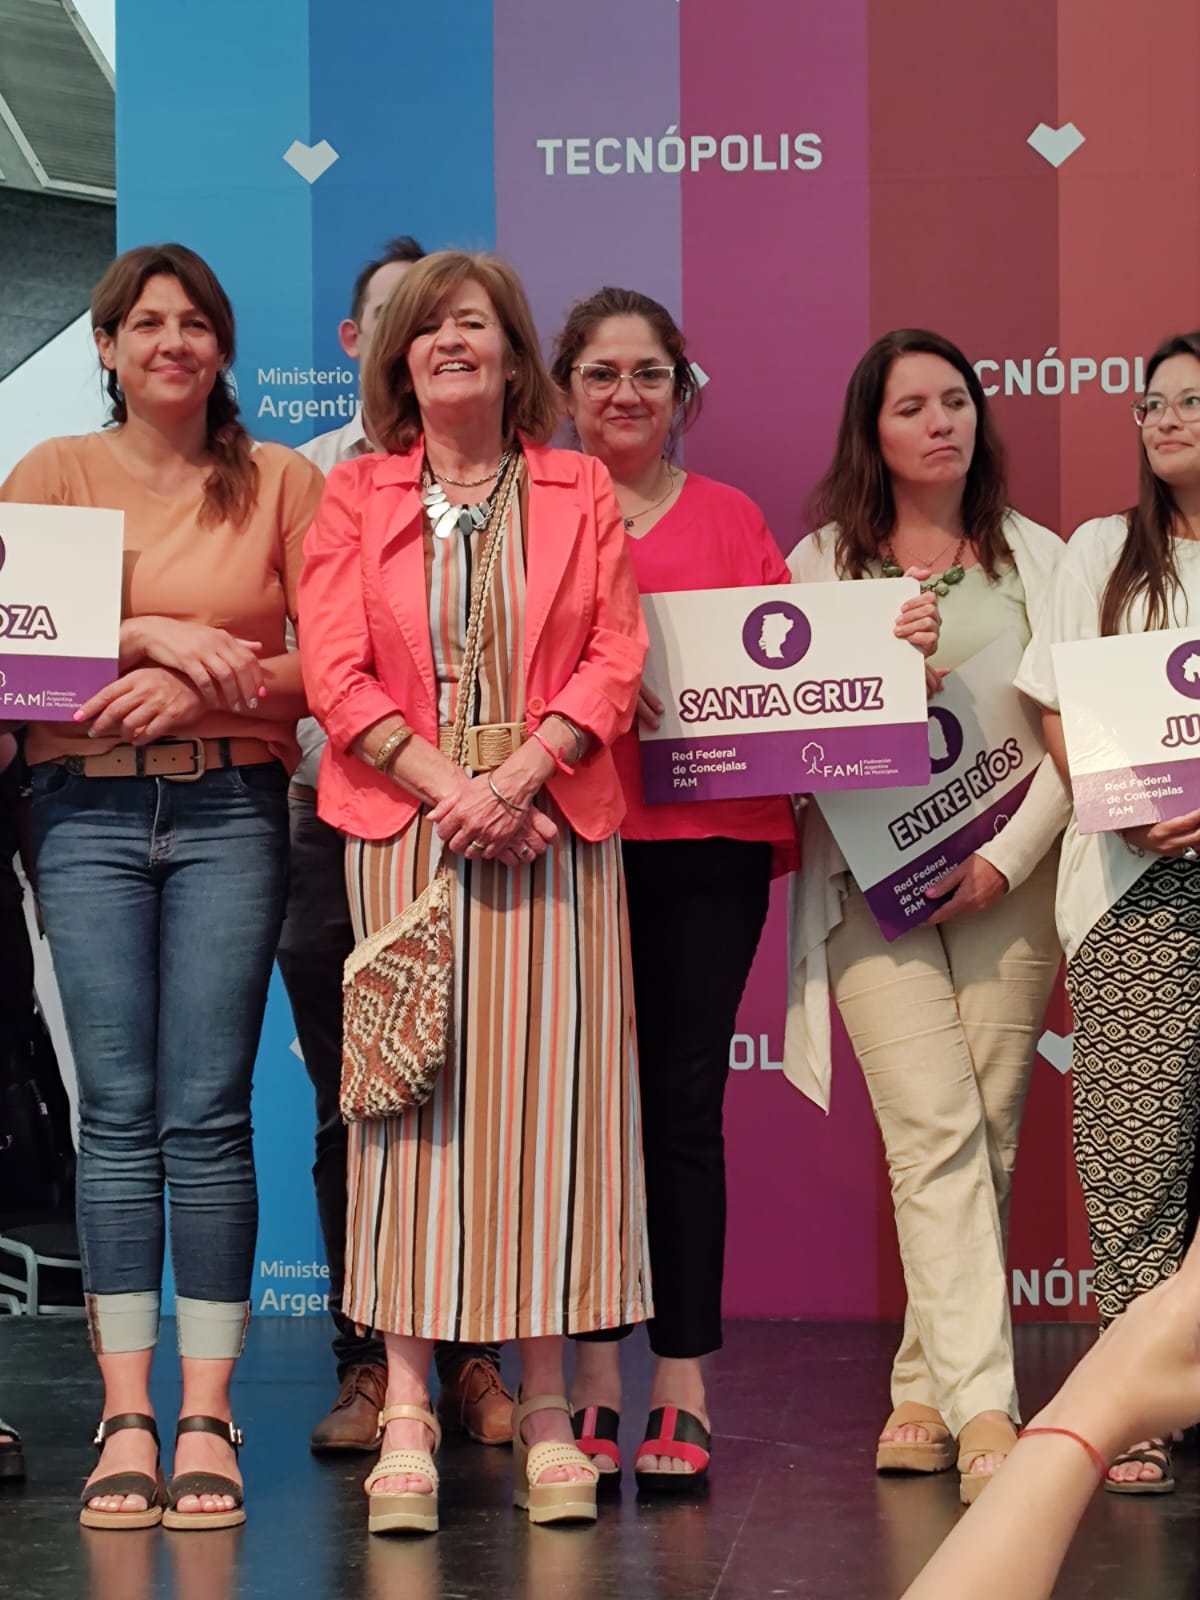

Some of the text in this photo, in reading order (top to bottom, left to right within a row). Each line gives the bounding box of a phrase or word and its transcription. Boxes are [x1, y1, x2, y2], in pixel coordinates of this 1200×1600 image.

[536, 125, 823, 175] TECNÓPOLIS
[257, 366, 353, 385] Ministerio
[3, 692, 41, 706] FAM
[679, 676, 884, 723] SANTA CRUZ
[671, 747, 737, 761] Red Federal
[672, 761, 747, 775] de Concejalas
[823, 763, 859, 778] FAM
[673, 777, 698, 788] FAM
[1104, 774, 1172, 793] Red Federal
[888, 737, 1023, 851] ENTRE RÍOS
[1107, 785, 1184, 804] de Concejalas
[1109, 806, 1134, 817] FAM
[893, 855, 947, 895] Red Federal
[900, 894, 912, 906] de
[904, 898, 926, 916] FAM
